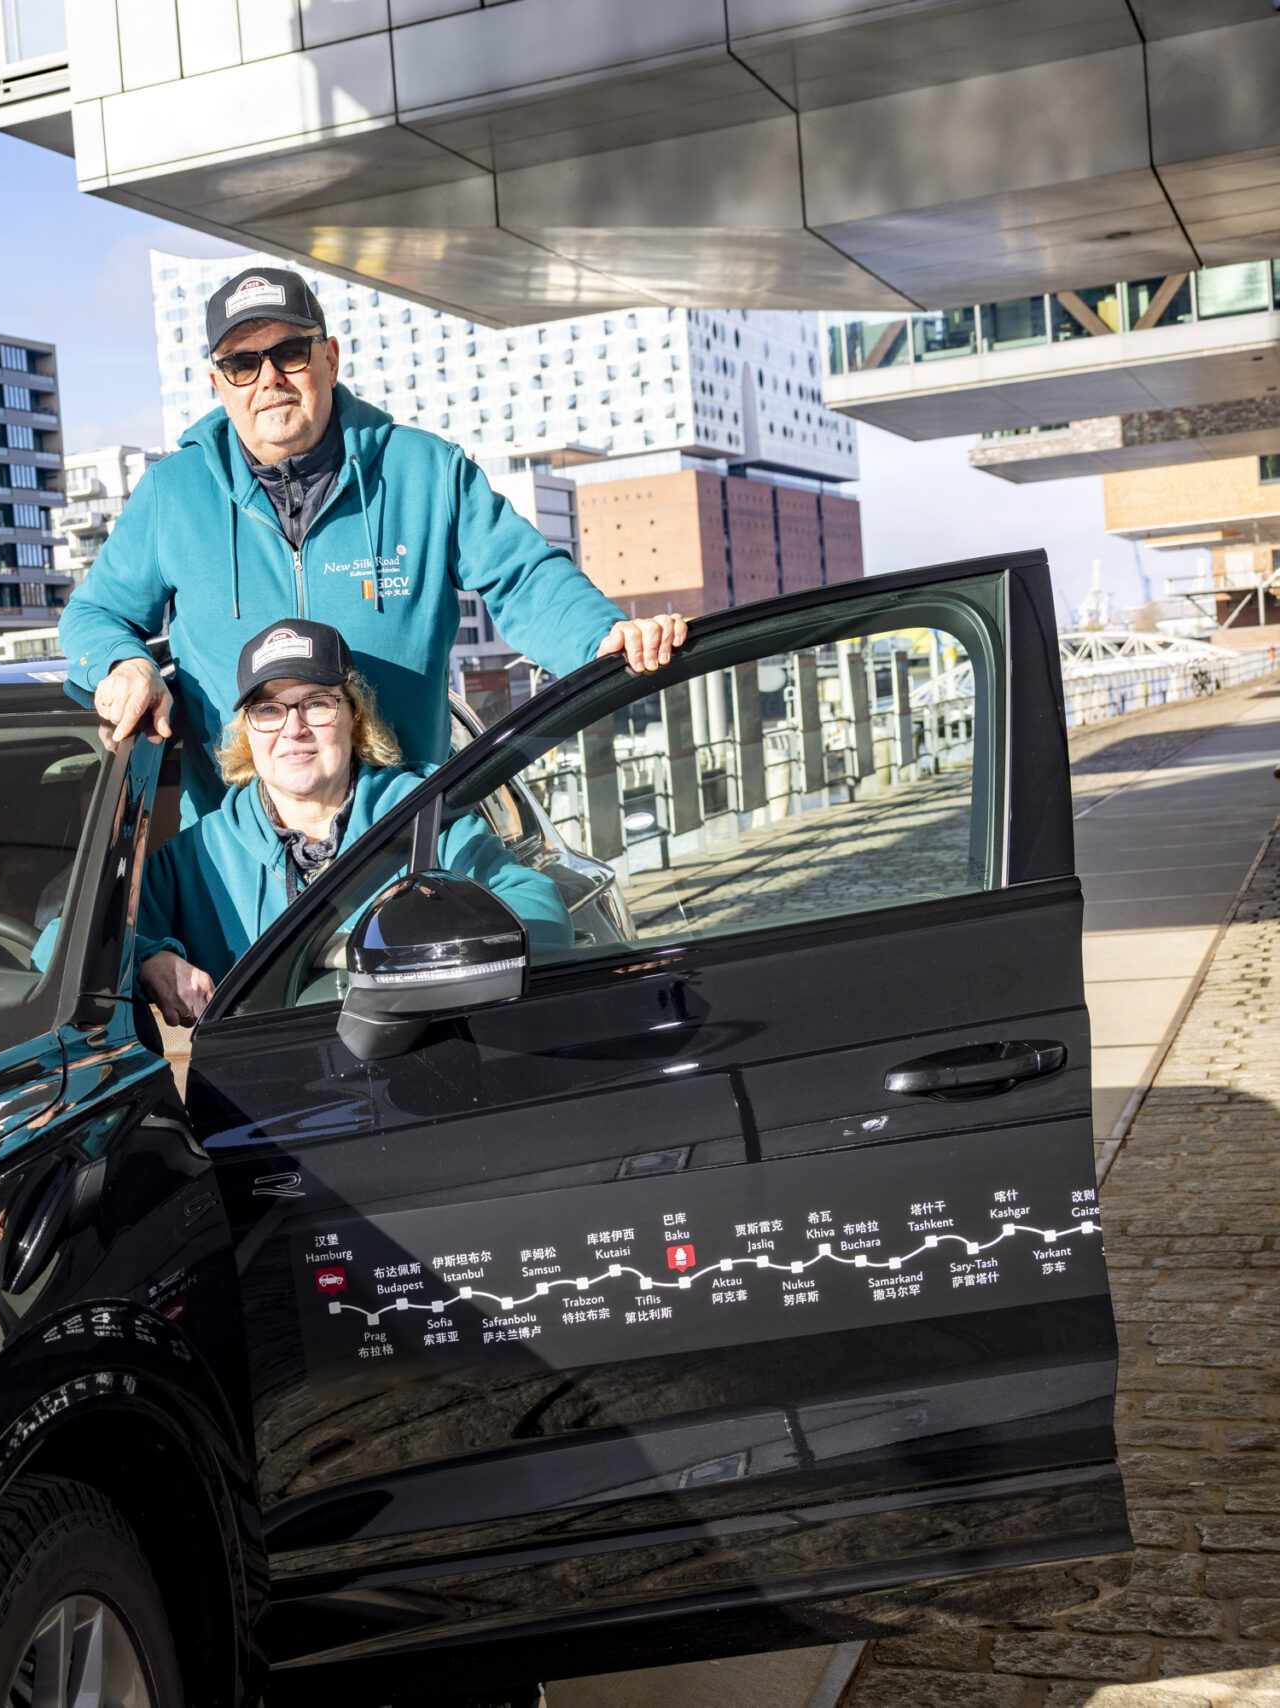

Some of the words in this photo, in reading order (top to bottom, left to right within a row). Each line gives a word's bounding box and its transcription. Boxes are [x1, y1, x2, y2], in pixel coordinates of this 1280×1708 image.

[324, 562, 350, 575] New
[353, 558, 373, 570] Silk
[375, 555, 400, 567] Road
[995, 1189, 1018, 1202] 喀什
[1072, 1189, 1095, 1202] 改则
[911, 1201, 946, 1215] 塔什干
[990, 1207, 1030, 1218] Kashgar
[664, 1213, 686, 1225] 巴库
[808, 1211, 832, 1224] 希瓦
[735, 1219, 783, 1237] 贾斯雷克
[844, 1221, 879, 1235] 布哈拉
[908, 1219, 954, 1231] Tashkent
[588, 1228, 634, 1245] 库塔伊西
[665, 1230, 689, 1241] Baku
[806, 1228, 835, 1239] Khiva
[316, 1234, 339, 1247] 汉堡
[748, 1239, 774, 1252] Jasliq
[841, 1239, 880, 1250] Buchara
[306, 1251, 352, 1262] Hamburg
[521, 1247, 556, 1262] 萨姆松
[596, 1246, 630, 1259] Kutaisi
[1033, 1248, 1071, 1259] Yarkant
[432, 1251, 492, 1270] 伊斯坦布尔
[951, 1257, 998, 1273] Sary-Tash
[374, 1262, 421, 1279] 布达佩斯
[522, 1266, 560, 1277] Samsun
[1042, 1261, 1065, 1274] 莎车
[443, 1268, 484, 1282] Istanbul
[868, 1272, 923, 1289] Samarkand
[951, 1270, 999, 1288] 萨雷塔什
[377, 1281, 423, 1294] Budapest
[712, 1276, 743, 1288] Aktau
[783, 1279, 815, 1290] Nukus
[712, 1289, 747, 1304] 阿克套
[783, 1290, 819, 1306] 努库斯
[873, 1284, 920, 1301] 撒马尔罕
[562, 1295, 605, 1308] Trabzon
[635, 1295, 661, 1306] Tiflis
[482, 1313, 537, 1328] Safranbolu
[563, 1308, 610, 1324] 特拉布宗
[625, 1307, 672, 1324] 第比利斯
[427, 1318, 452, 1329] Sofia
[364, 1332, 386, 1342] Prag
[424, 1331, 459, 1345] 索菲亚
[483, 1325, 541, 1343] 萨夫兰博卢
[359, 1344, 393, 1358] 布拉格
